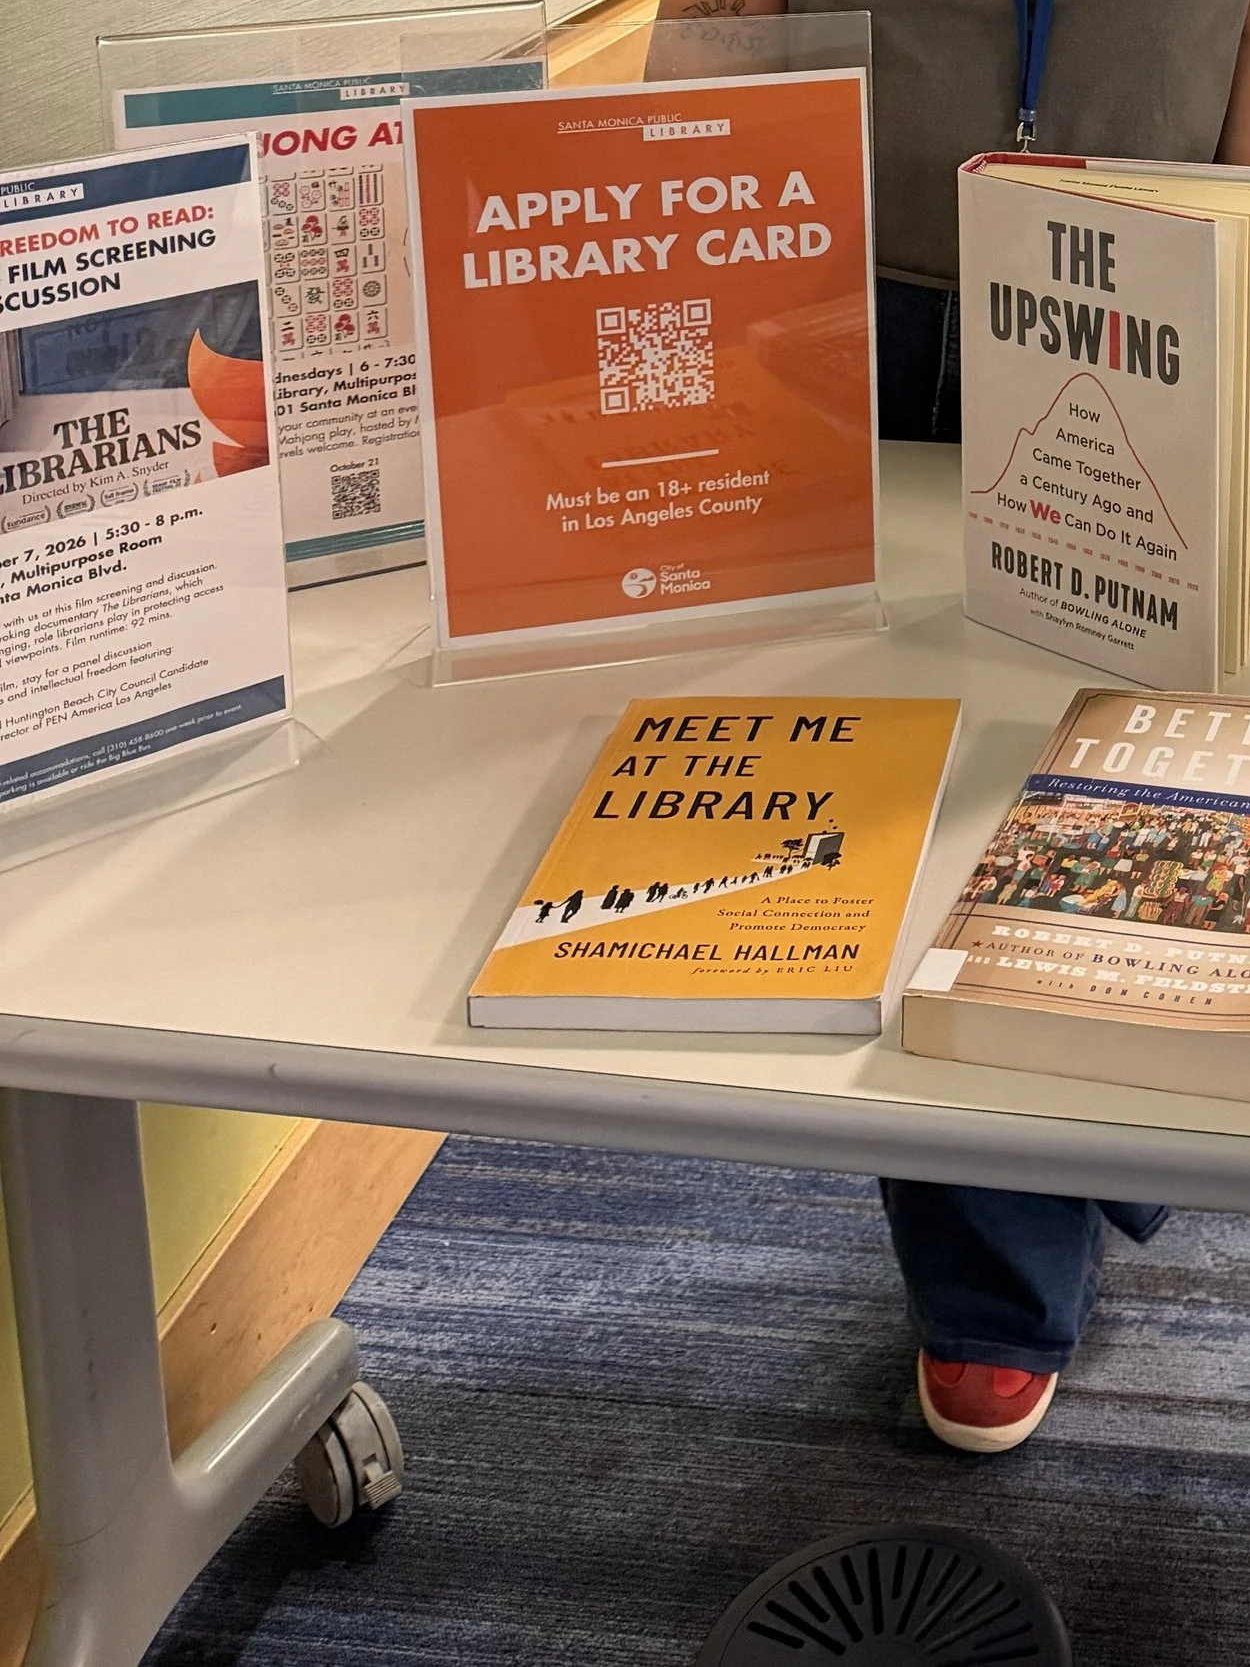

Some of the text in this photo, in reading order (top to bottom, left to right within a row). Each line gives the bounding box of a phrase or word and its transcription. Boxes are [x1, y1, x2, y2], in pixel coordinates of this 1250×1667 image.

[273, 77, 370, 93] SANTA MONICA PUBLIC
[345, 85, 405, 98] LIBRARY
[558, 113, 682, 131] SANTA MONICA PUBLIC
[649, 122, 725, 138] LIBRARY
[1, 182, 34, 194] PUBLIC
[3, 188, 79, 209] LIBRARY
[476, 171, 816, 234] APPLY FOR A
[107, 218, 139, 236] TO
[148, 206, 214, 229] READ:
[9, 230, 216, 284] FILM SCREENING
[463, 222, 831, 289] LIBRARY CARD
[1047, 221, 1116, 292] THE
[990, 281, 1180, 385] UPSWING
[1069, 402, 1101, 423] How
[53, 408, 130, 449] THE
[1056, 427, 1115, 456] America
[331, 458, 379, 472] October 21
[1033, 448, 1141, 494] Came Together
[22, 460, 169, 505] Directed by Kim A. Snyder
[546, 471, 770, 511] Must be an 18+ resident
[1020, 474, 1153, 523] a Century Ago and
[561, 495, 762, 533] in Los Angeles County
[997, 493, 1178, 562] How We Can Do It Again
[25, 549, 39, 564] 7,
[45, 536, 85, 557] 2026
[106, 520, 140, 540] 5:30
[156, 515, 164, 526] 8
[171, 510, 203, 527] p.m.
[11, 534, 162, 581] Multipurpose Room
[26, 563, 127, 598] Monica Blvd.
[660, 568, 701, 582] Santa
[661, 578, 711, 594] Monica
[991, 541, 1064, 591] ROBERT
[1071, 566, 1090, 599] D.
[1095, 574, 1178, 630] PUTNAM
[1020, 587, 1146, 638] Author of BOWLING ALONE
[633, 716, 861, 742] MEET ME
[612, 756, 761, 776] AT THE
[1048, 778, 1128, 798] Restoring
[1135, 787, 1162, 800] the
[593, 791, 833, 820] LIBRARY
[718, 909, 870, 918] Social Connection and
[776, 896, 810, 905] Place
[815, 897, 828, 905] to
[832, 896, 875, 905] Foster
[730, 922, 866, 933] Promote Democracy
[554, 942, 859, 961] SHAMICHAEL HALLMAN
